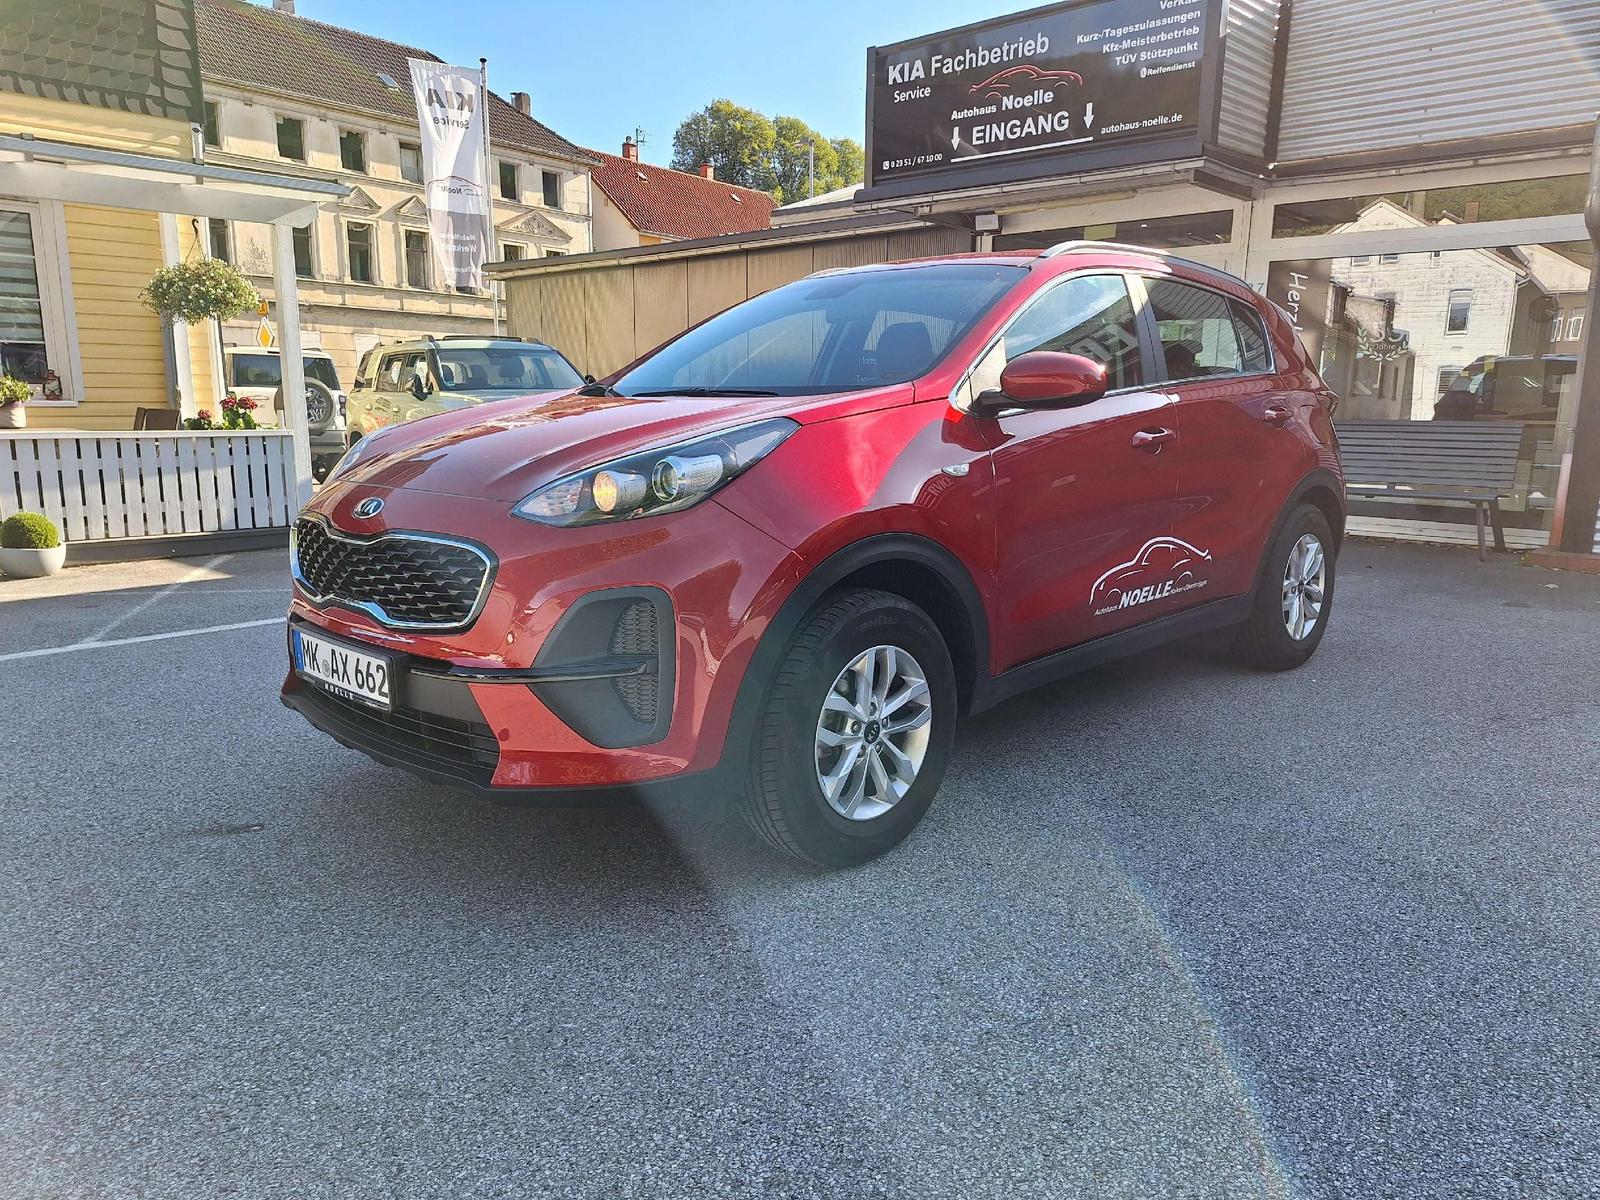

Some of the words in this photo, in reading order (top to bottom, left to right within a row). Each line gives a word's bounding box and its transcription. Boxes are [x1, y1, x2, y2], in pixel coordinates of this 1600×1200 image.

[1160, 0, 1201, 9] Verka
[1077, 10, 1200, 44] Kurz-/Tageszulassungen
[1102, 25, 1200, 54] Kfz-Meisterbetrieb
[888, 59, 925, 85] KIA
[931, 32, 1049, 77] Fachbetrieb
[1115, 52, 1138, 66] TÜV
[1140, 41, 1199, 61] Stützpunkt
[1147, 60, 1196, 76] Reifendienst
[893, 86, 931, 103] Service
[951, 104, 997, 121] Autohaus
[1002, 88, 1054, 111] Noelle
[972, 110, 1070, 146] EINGANG
[1101, 113, 1183, 135] autohaus-noelle.de
[1118, 579, 1174, 610] NOELLE
[302, 637, 321, 674] MK
[331, 648, 351, 686] AX
[355, 657, 389, 699] 662
[324, 682, 354, 700] NOELLE
